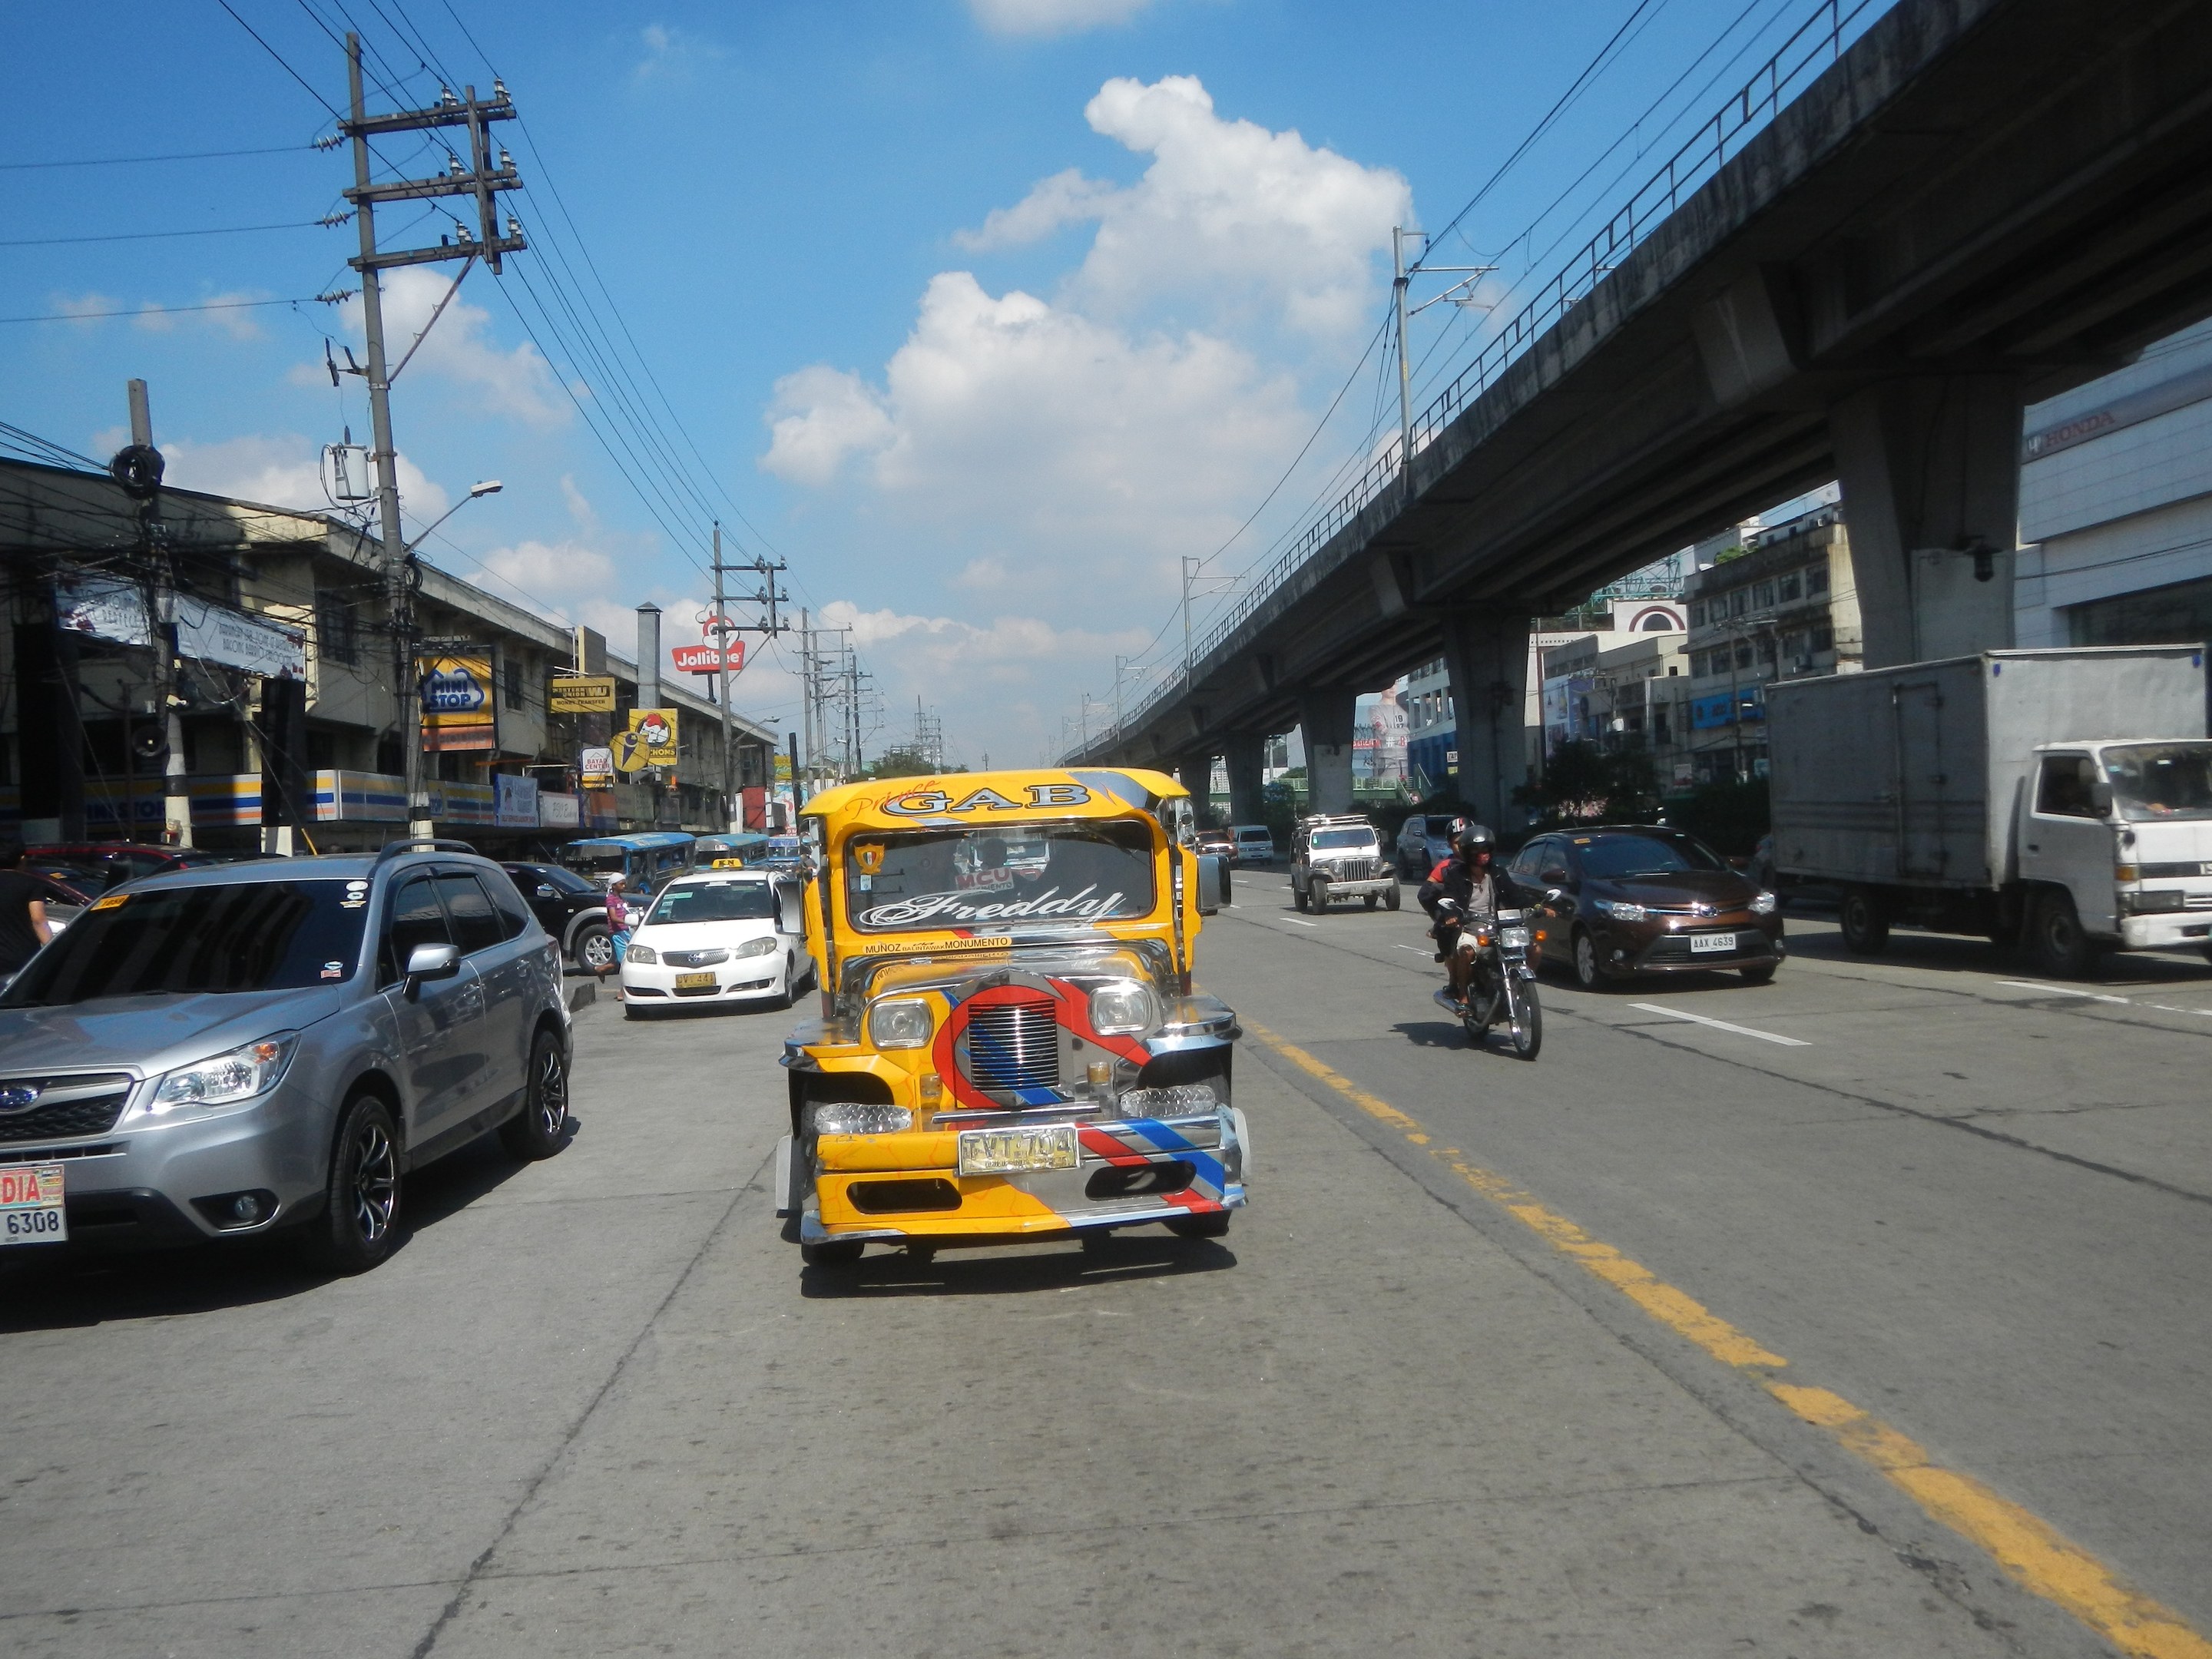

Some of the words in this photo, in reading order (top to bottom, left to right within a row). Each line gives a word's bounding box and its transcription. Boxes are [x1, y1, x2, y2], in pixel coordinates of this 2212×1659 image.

[2045, 412, 2114, 447] HONDA
[677, 650, 739, 667] Jollibe
[431, 680, 468, 693] MINI
[430, 694, 470, 707] STOP
[845, 780, 941, 820] Prince
[879, 783, 1091, 816] GAB
[956, 868, 1010, 889] MCU
[859, 883, 1127, 929] Freddy
[945, 938, 1008, 949] MONUMENTO
[1694, 939, 1709, 948] AAX
[1713, 937, 1734, 946] 4639
[1021, 1131, 1072, 1156] 704
[7, 1211, 59, 1234] 6308
